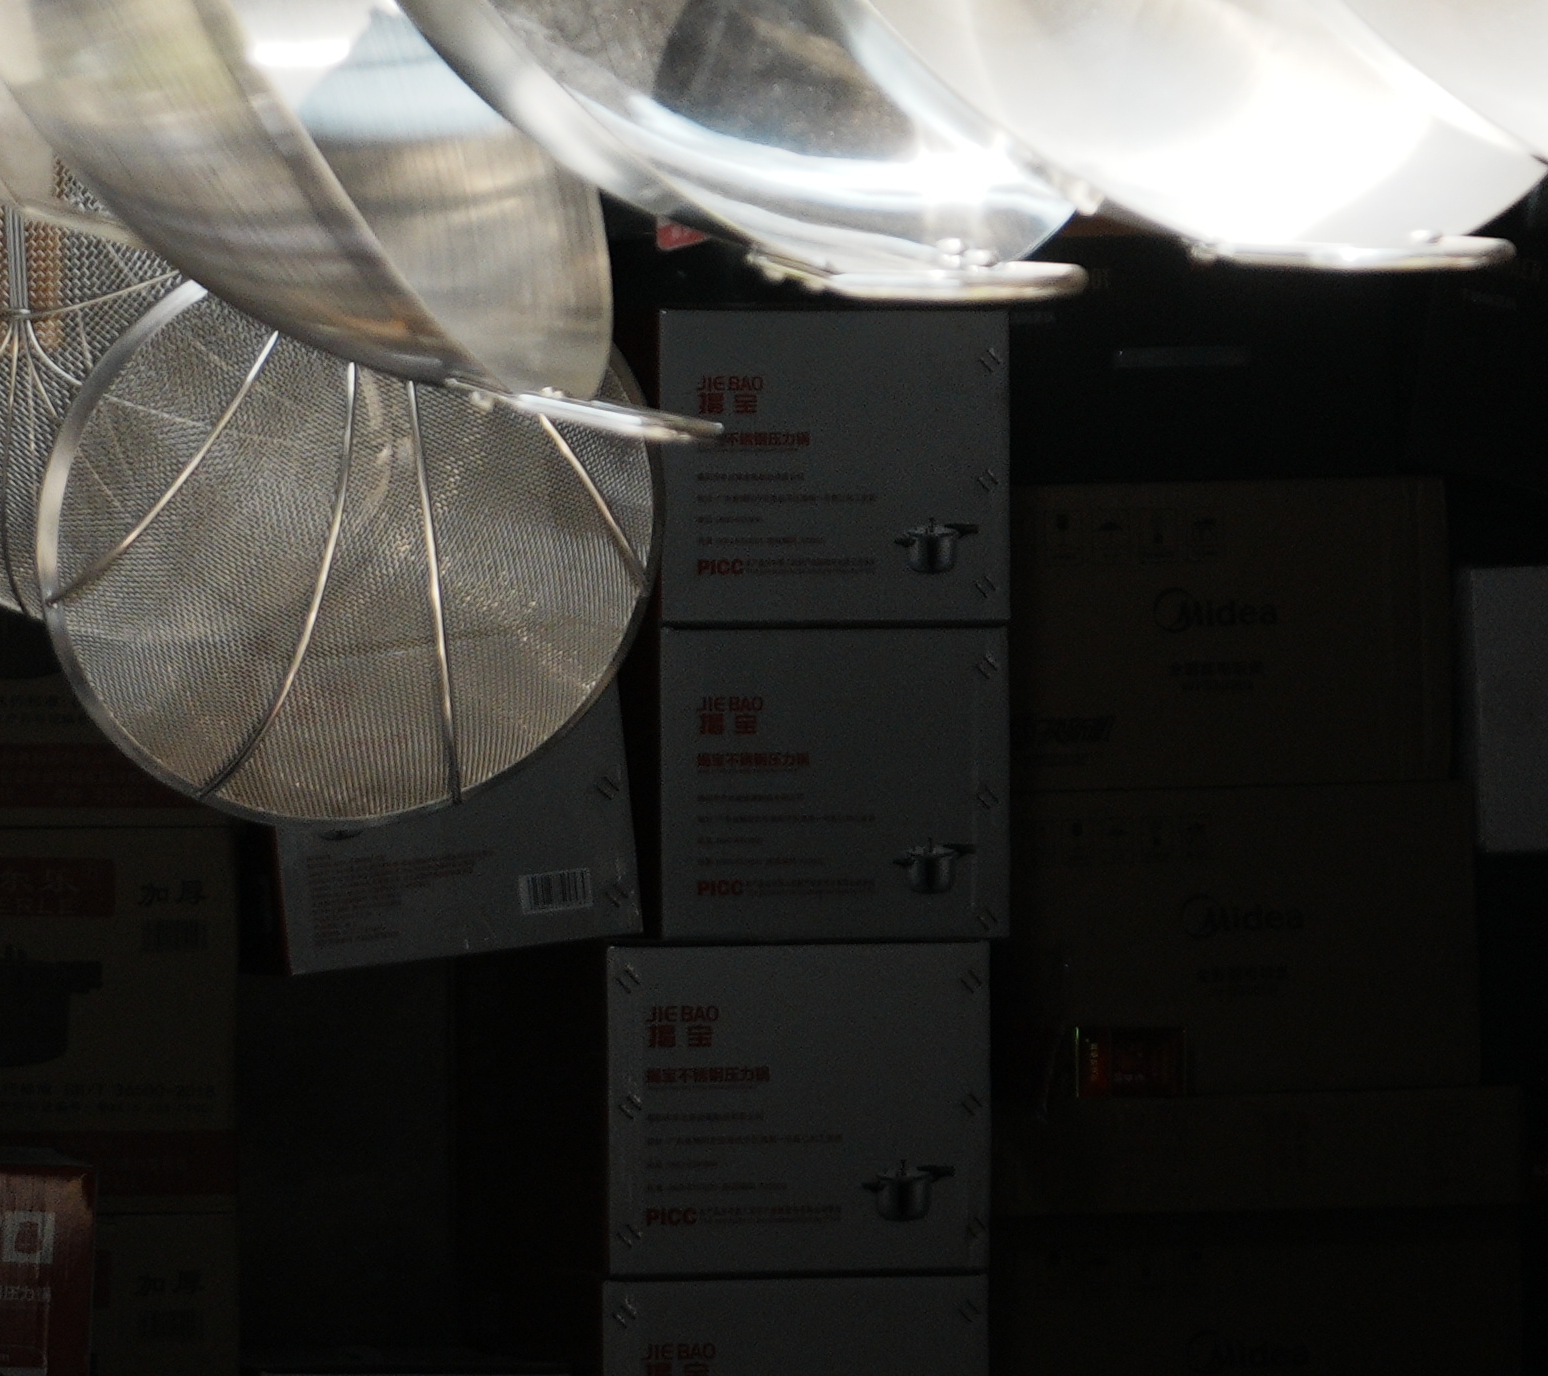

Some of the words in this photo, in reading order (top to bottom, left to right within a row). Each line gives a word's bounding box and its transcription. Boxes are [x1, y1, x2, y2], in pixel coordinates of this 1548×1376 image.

[697, 376, 724, 392] JIE
[728, 376, 763, 392] BAO
[697, 558, 744, 575] PICC
[1157, 590, 1279, 633] Midea
[696, 696, 724, 712] JIE
[728, 696, 764, 712] BAO
[137, 880, 206, 907] 加厚
[697, 879, 744, 897] PICC
[1184, 897, 1304, 937] Midea
[645, 1005, 677, 1024] JIE
[681, 1005, 719, 1023] BAO
[645, 1207, 697, 1226] PICC
[134, 1270, 202, 1297] 加厚
[642, 1343, 673, 1362] JIE
[677, 1342, 716, 1361] BAO
[1190, 1333, 1310, 1373] Midea
